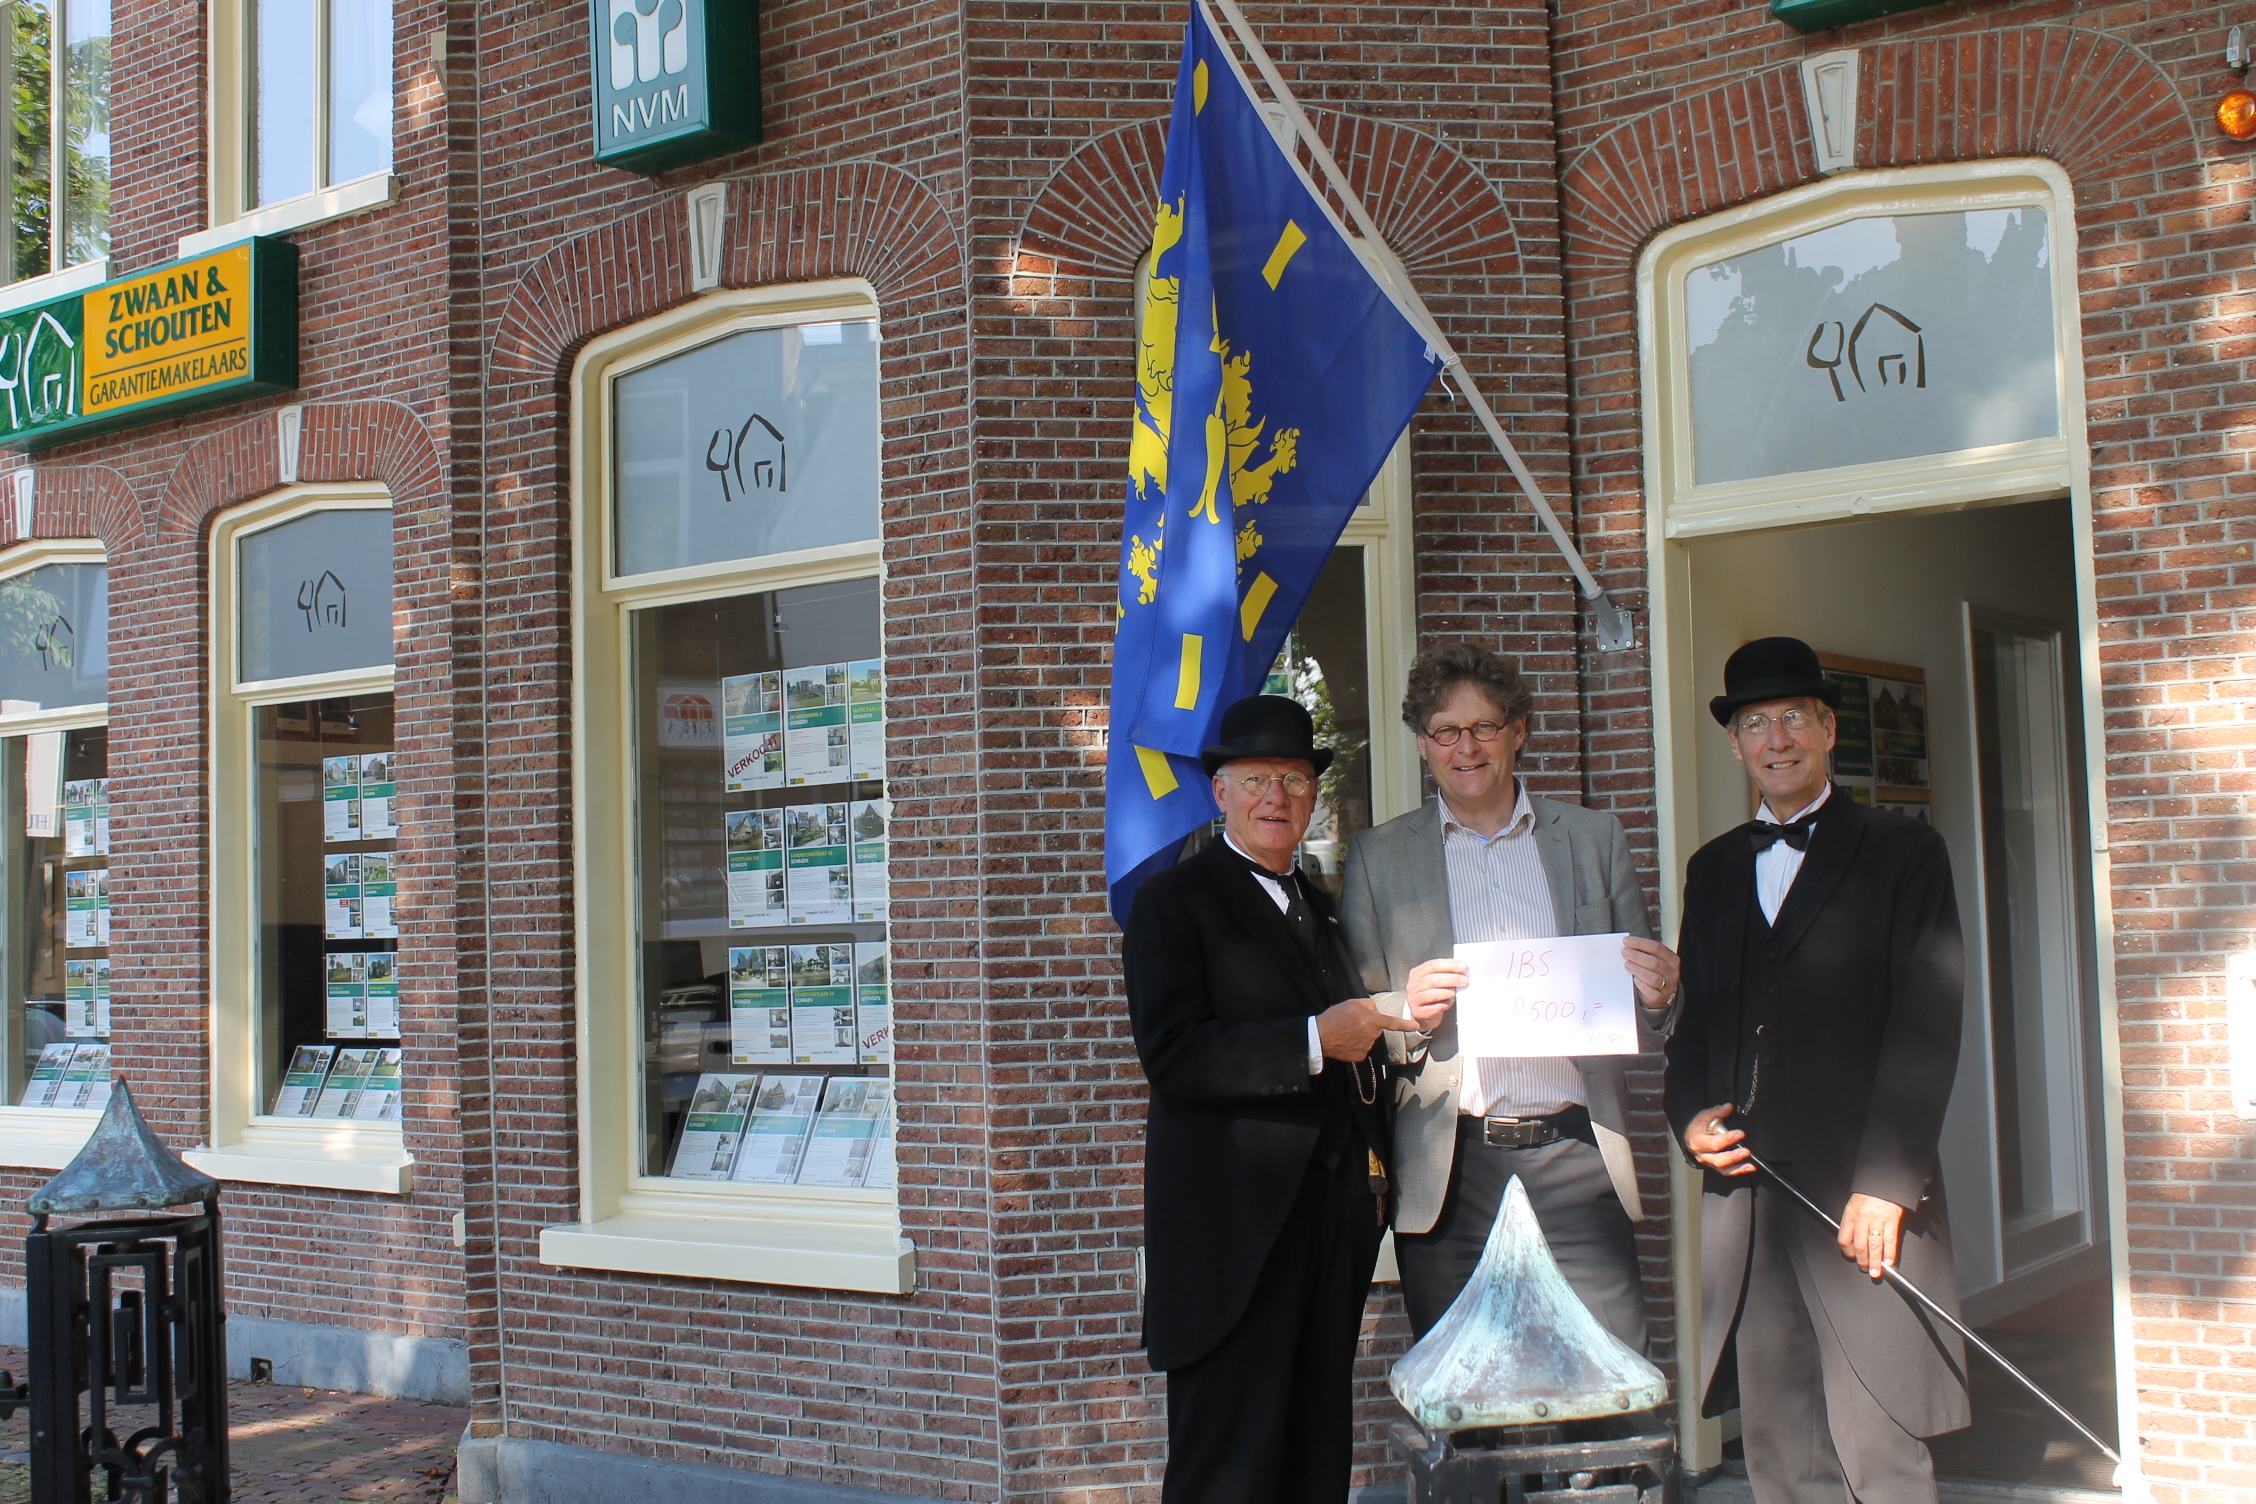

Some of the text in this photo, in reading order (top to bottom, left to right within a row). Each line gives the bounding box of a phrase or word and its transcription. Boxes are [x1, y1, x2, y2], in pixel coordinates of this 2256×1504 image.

[612, 83, 689, 138] NVM
[109, 265, 229, 323] ZWAAN &
[105, 298, 232, 359] SCHOUTEN
[89, 347, 248, 406] GARANTIEMAKELAARS
[1506, 950, 1554, 980] IBS
